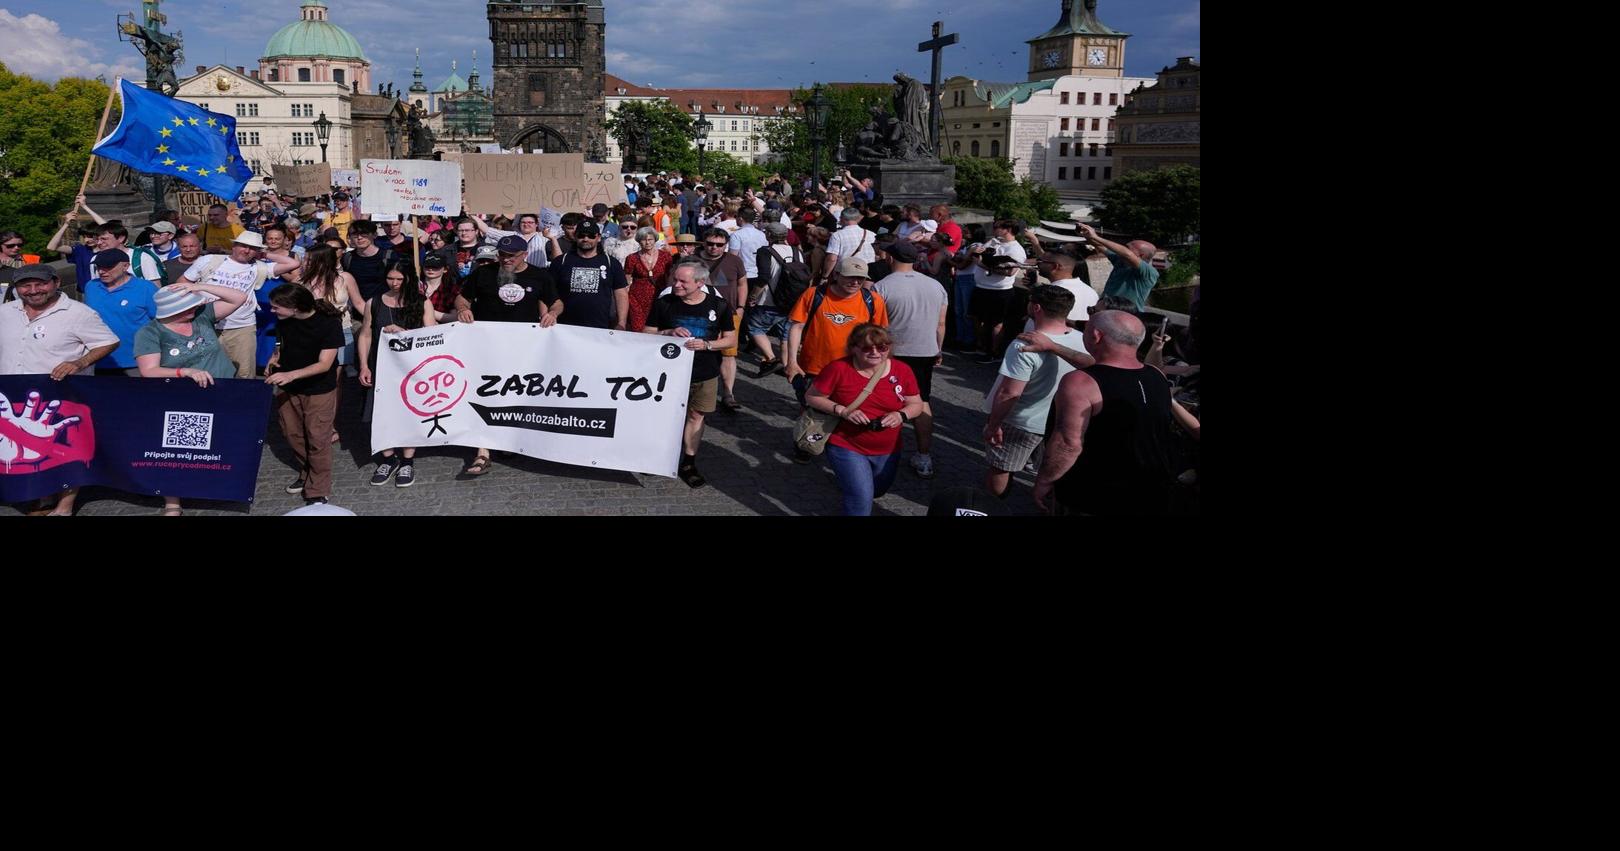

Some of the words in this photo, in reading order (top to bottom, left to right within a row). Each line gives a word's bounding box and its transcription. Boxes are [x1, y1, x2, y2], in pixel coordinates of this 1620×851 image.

[429, 203, 446, 213] dnes
[414, 371, 455, 395] OTO
[476, 373, 588, 398] ZABAL
[605, 372, 667, 402] TO!
[489, 411, 607, 430] www.otozabalto.cz
[144, 451, 175, 459] Připojte
[177, 452, 192, 460] svůj
